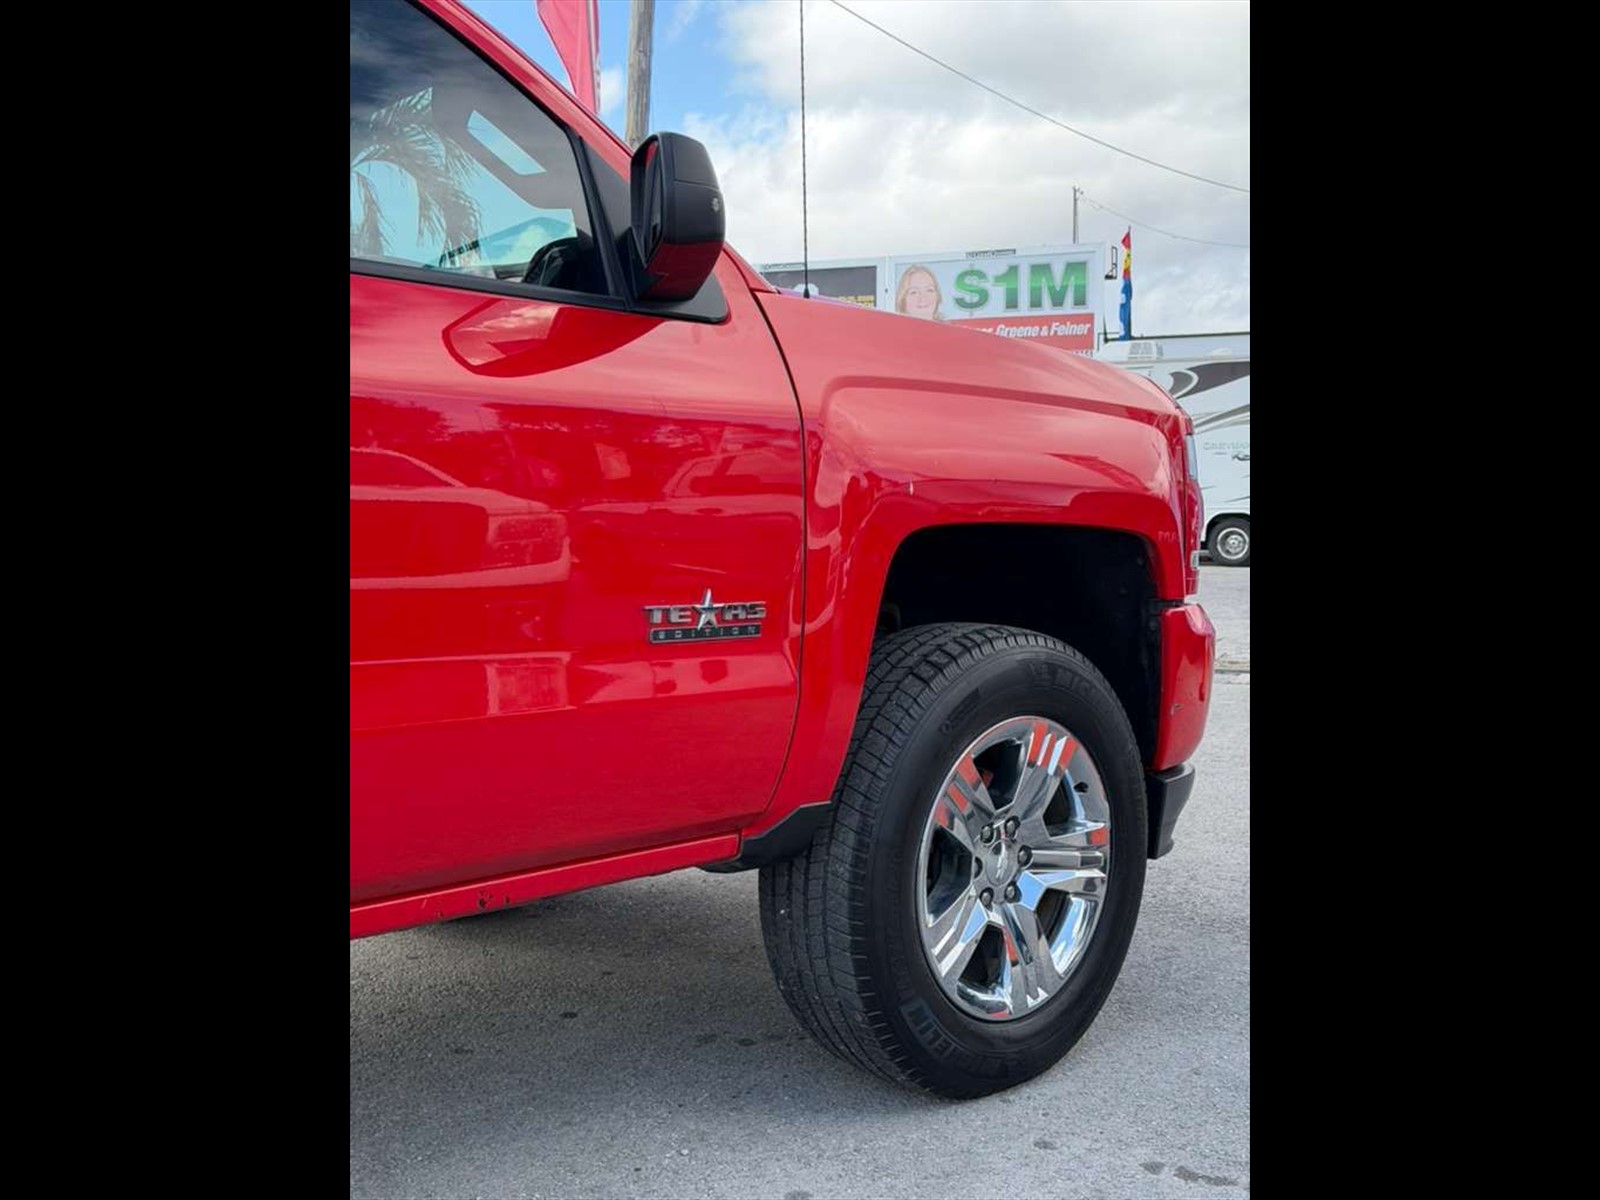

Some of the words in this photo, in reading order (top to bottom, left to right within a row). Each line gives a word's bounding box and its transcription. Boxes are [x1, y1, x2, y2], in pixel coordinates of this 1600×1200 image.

[954, 261, 1088, 312] $1M
[995, 323, 1040, 338] Greene
[1050, 321, 1092, 337] Feiner
[643, 590, 767, 629] TEXAS
[657, 625, 757, 641] EDITION
